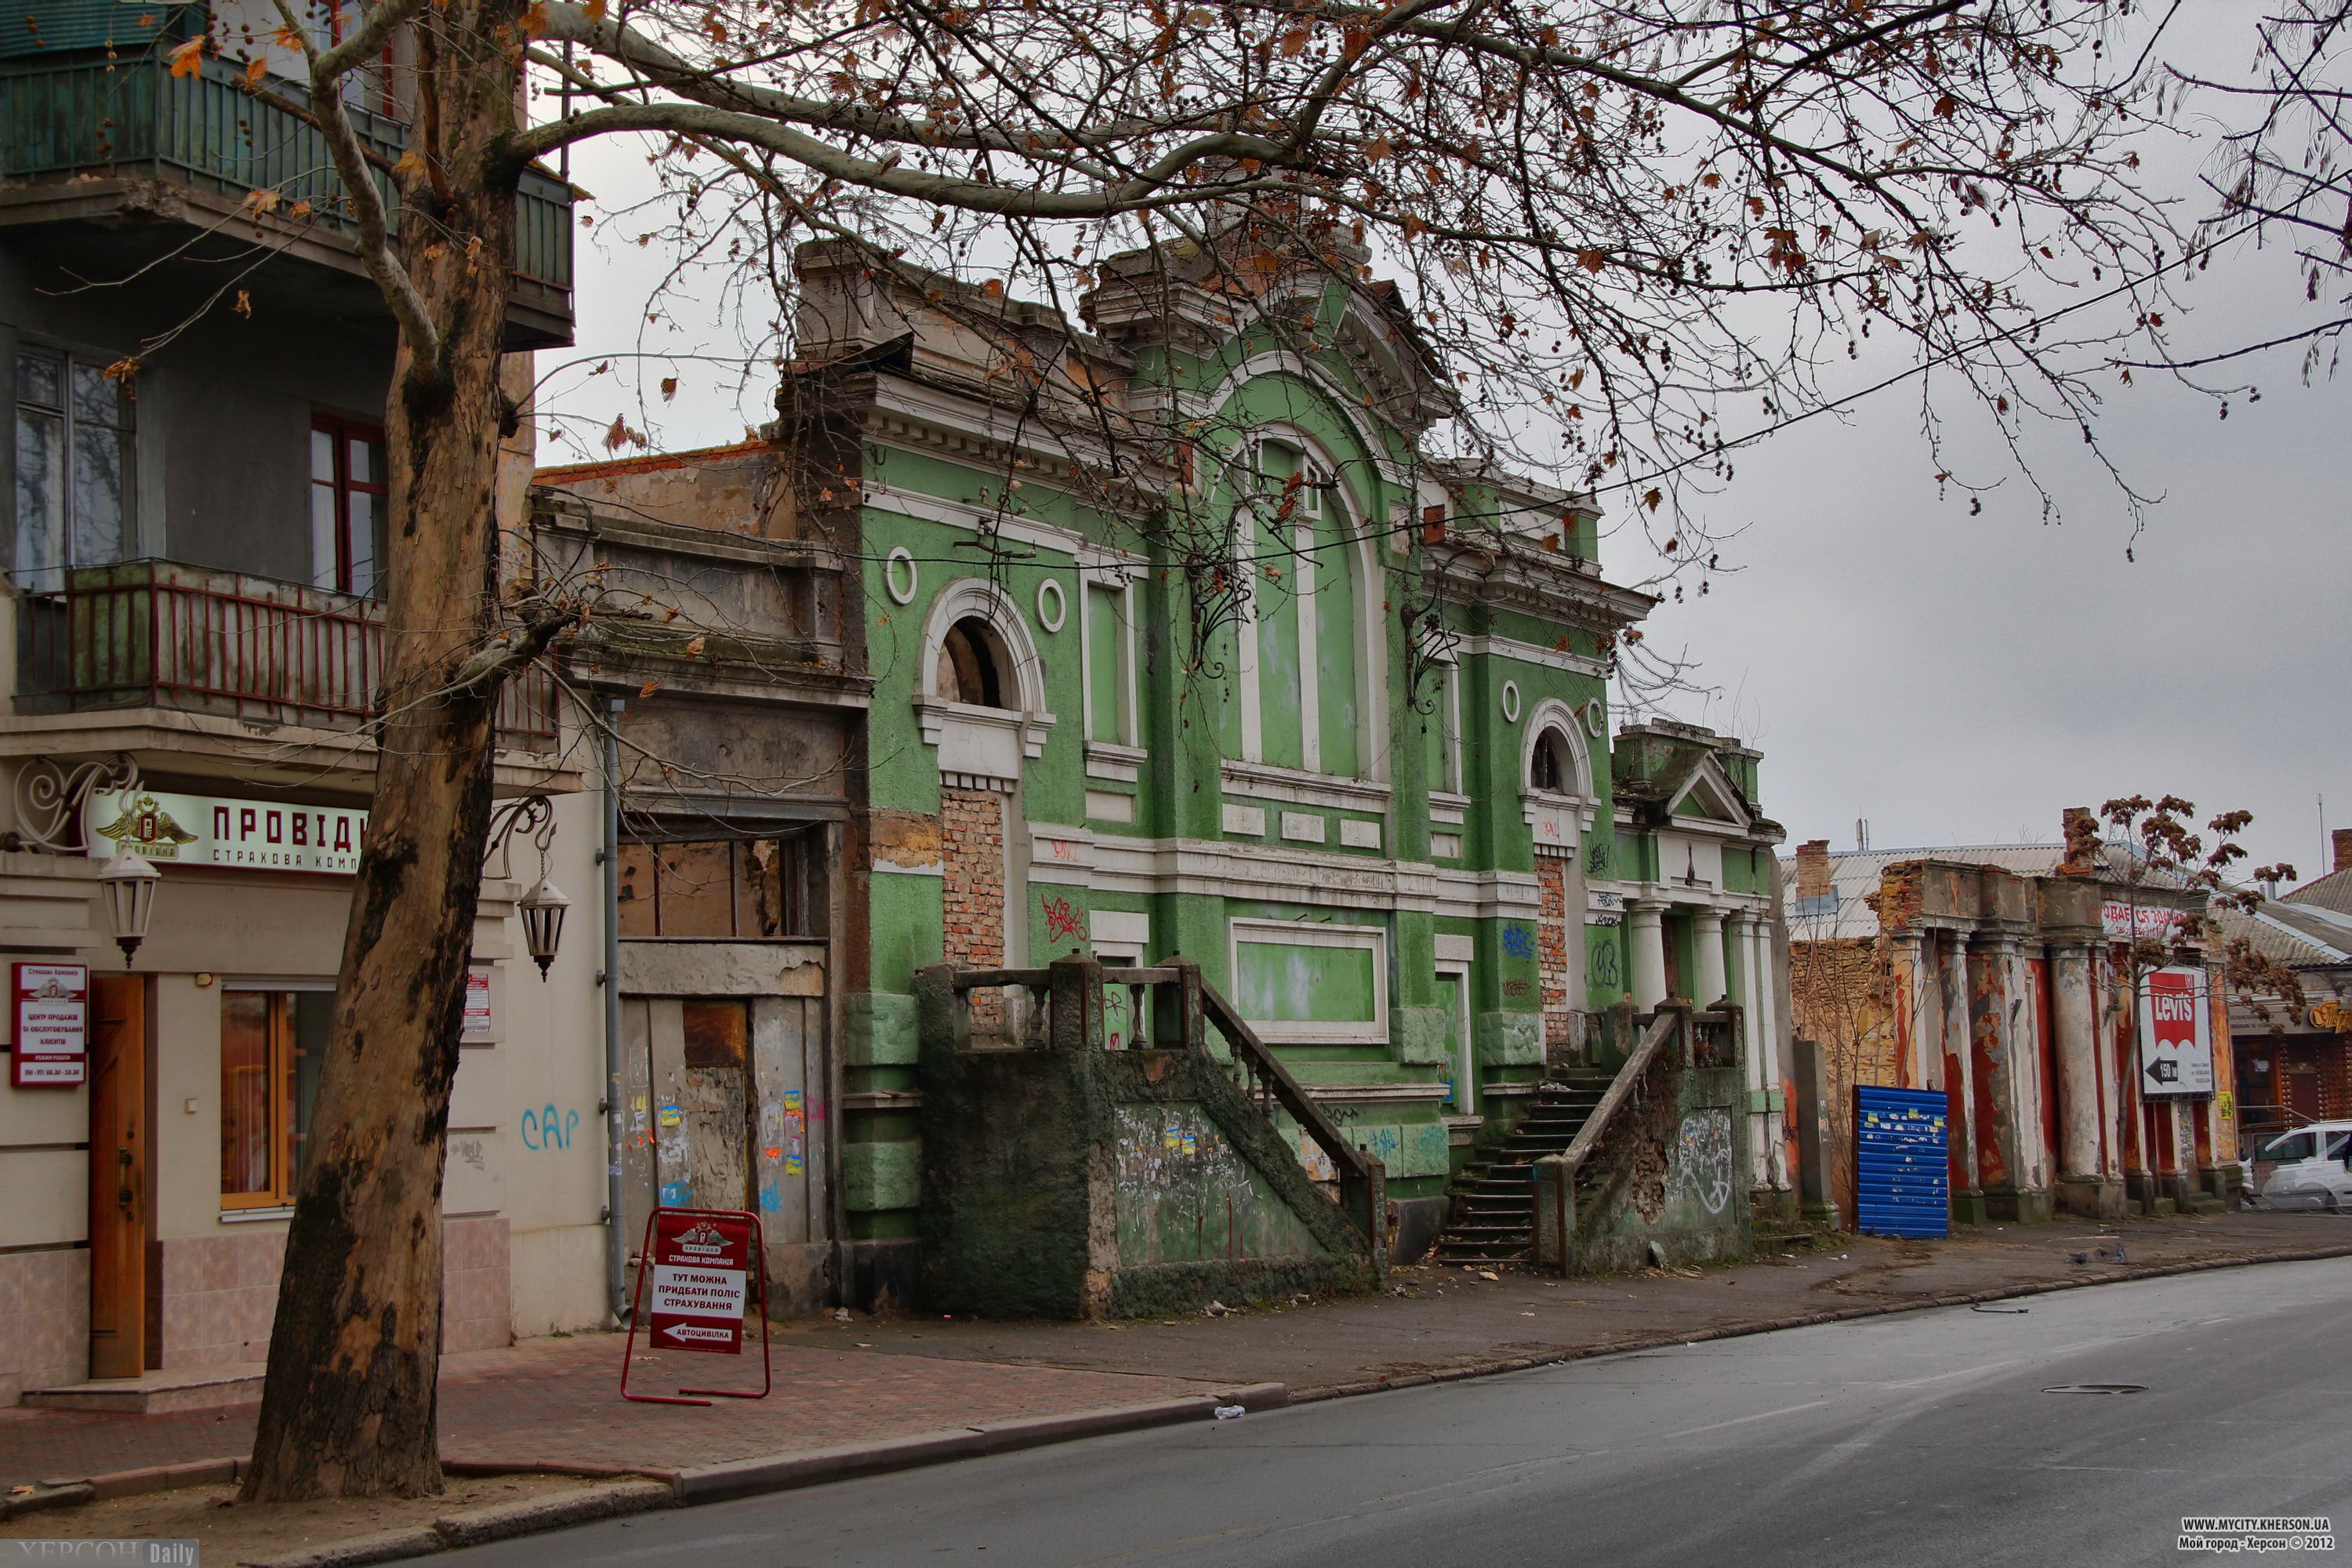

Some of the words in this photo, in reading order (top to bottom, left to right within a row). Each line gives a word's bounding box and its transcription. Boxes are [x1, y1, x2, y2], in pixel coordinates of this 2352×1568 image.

[213, 849, 302, 866] СТРАХОВА
[315, 855, 357, 869] КОМП
[2160, 1063, 2171, 1078] 150
[669, 1254, 700, 1264] СТРАХОВА
[702, 1257, 734, 1265] КОМПАНІЯ
[673, 1273, 689, 1282] ТУТ
[691, 1275, 728, 1284] МОЖНА
[659, 1285, 708, 1296] ПРИДБАТИ
[710, 1288, 740, 1298] ПОЛІС
[664, 1298, 732, 1310] СТРАХУВАННЯ
[677, 1329, 729, 1338] АВТОЦИВІЛКА
